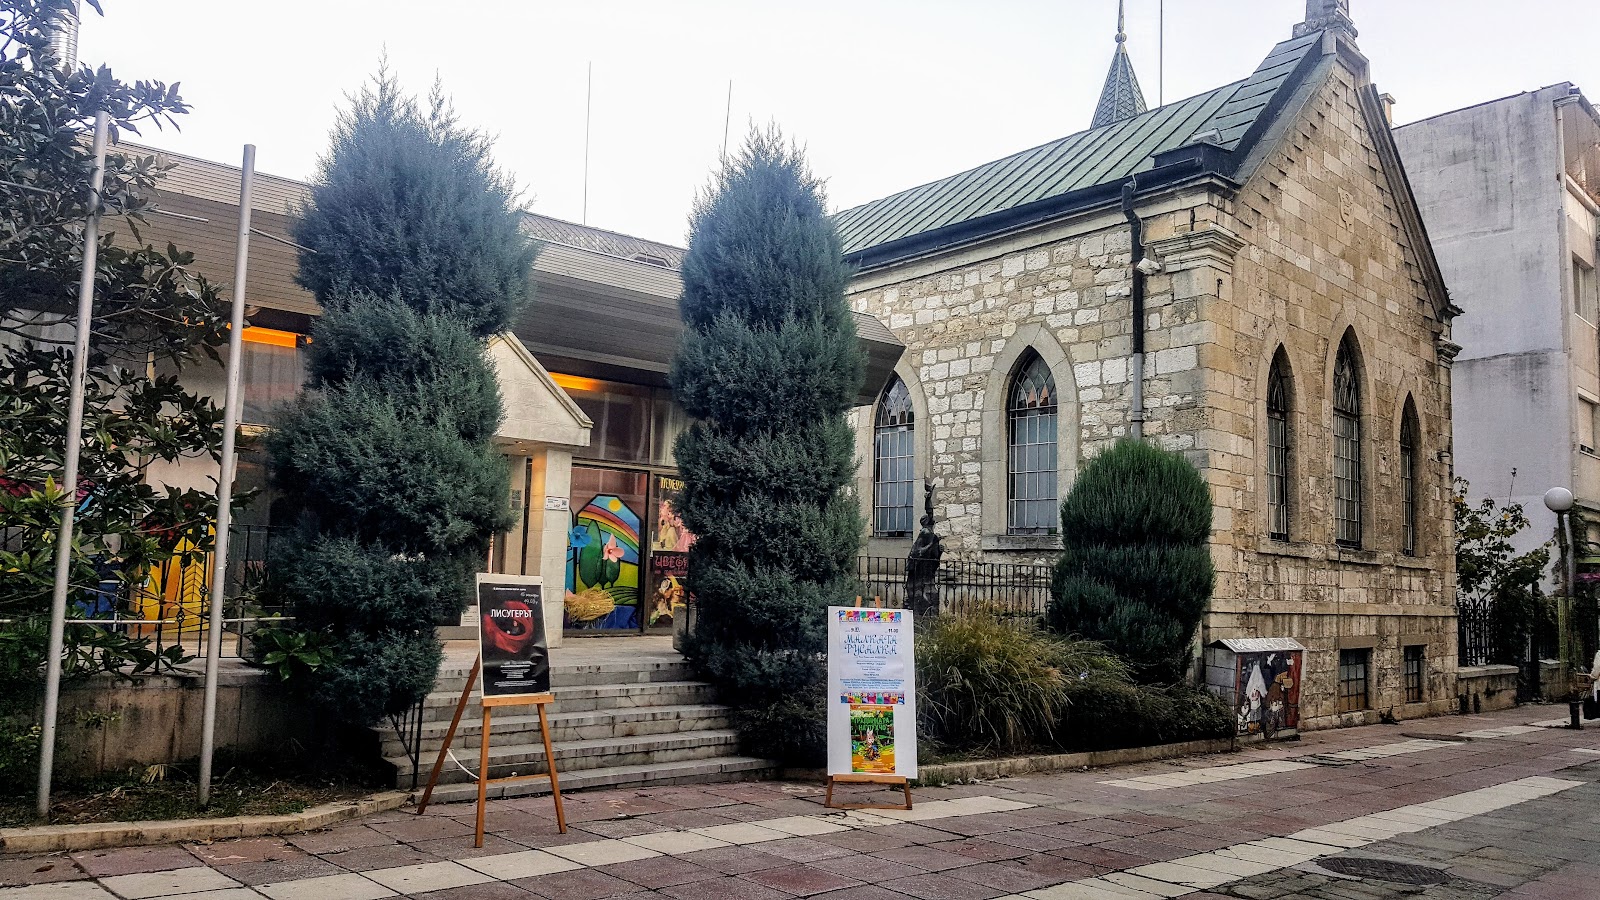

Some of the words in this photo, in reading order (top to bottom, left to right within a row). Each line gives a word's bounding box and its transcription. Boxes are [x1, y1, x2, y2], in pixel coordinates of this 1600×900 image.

[490, 609, 533, 618] ЛИСУГЕРЪТ
[844, 634, 898, 645] МАЛКАТА
[844, 644, 898, 656] РУСАЛКА
